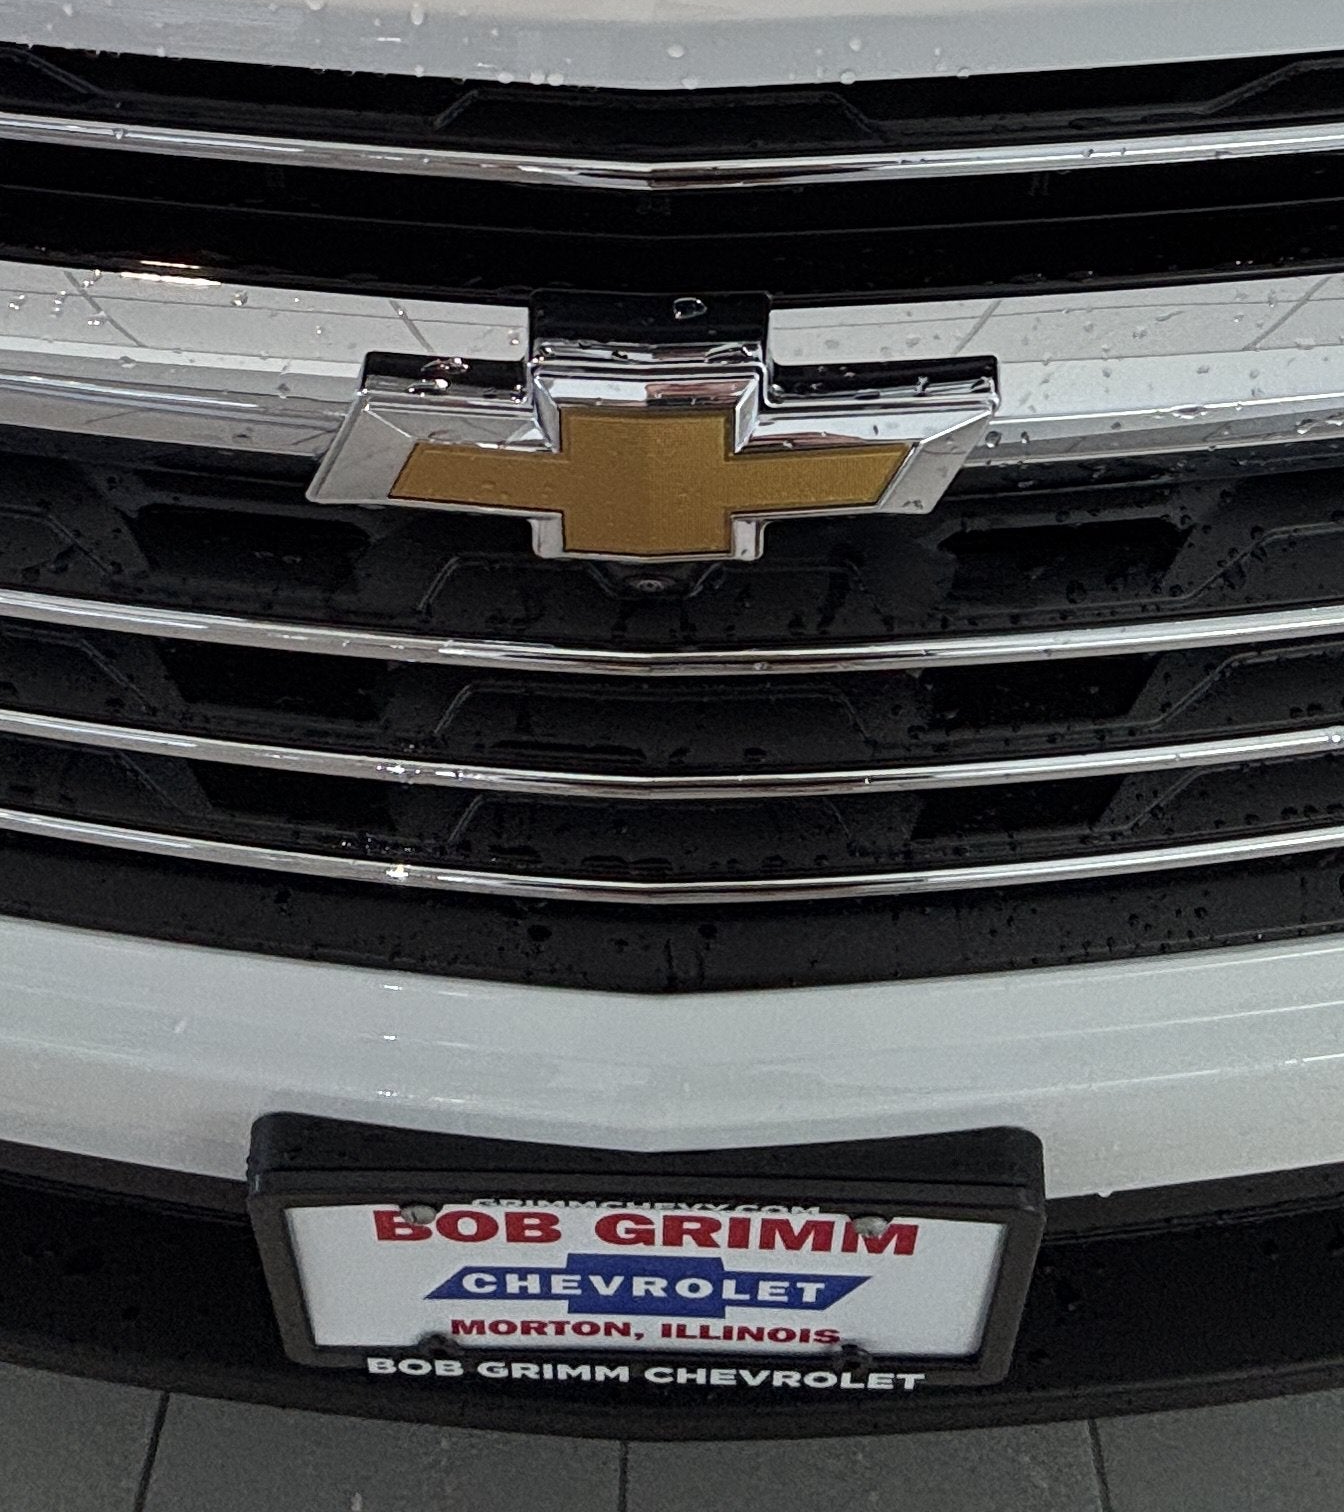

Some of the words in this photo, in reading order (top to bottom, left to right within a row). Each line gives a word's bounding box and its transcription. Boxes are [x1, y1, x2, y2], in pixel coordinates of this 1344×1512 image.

[472, 1199, 820, 1214] GRIMMCHEVYCOM
[373, 1209, 562, 1243] BOB
[594, 1212, 919, 1256] GRIMM
[462, 1272, 825, 1303] CHEVROLET
[450, 1319, 644, 1341] MORTON,
[661, 1323, 840, 1345] ILLINOIS
[367, 1357, 464, 1376] BOB
[477, 1361, 630, 1383] GRIMM
[644, 1366, 925, 1391] CHEVROLET
